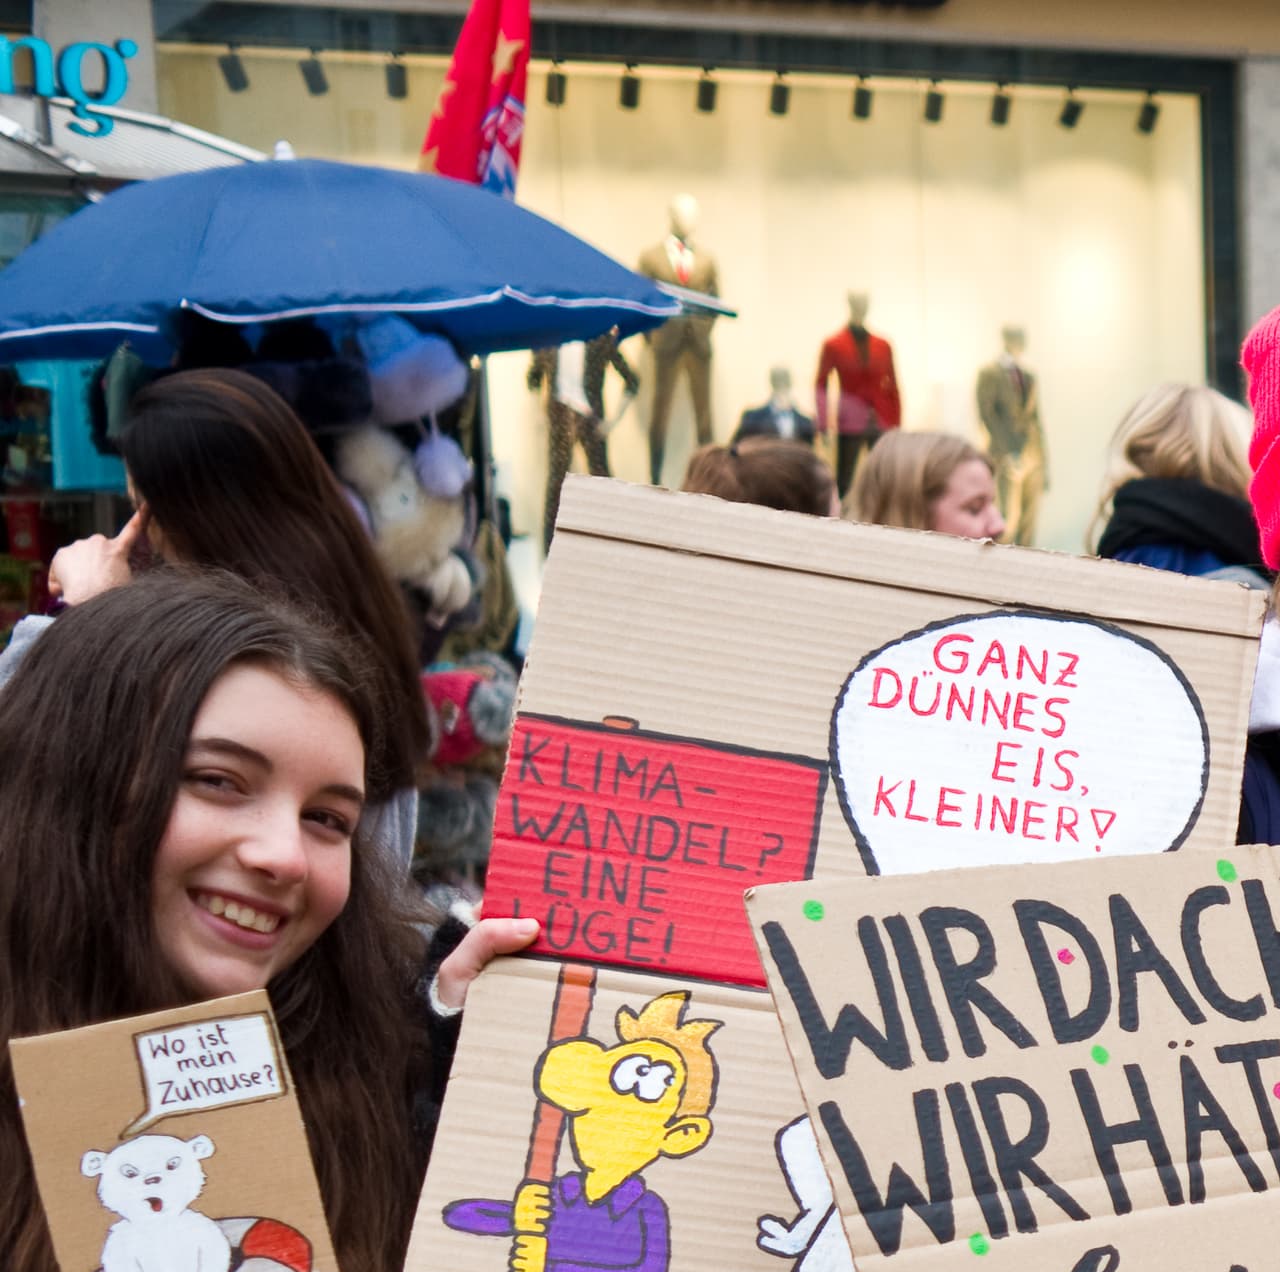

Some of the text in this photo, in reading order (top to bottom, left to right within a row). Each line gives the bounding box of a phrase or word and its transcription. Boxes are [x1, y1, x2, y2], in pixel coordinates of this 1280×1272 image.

[933, 633, 1079, 688] GANZ
[868, 668, 1070, 739] DÜNNES
[519, 731, 716, 808] KLIMA-
[991, 741, 1089, 796] EIS,
[511, 793, 784, 877] WANDEL?
[873, 776, 1117, 852] KLEINER!
[542, 850, 670, 914] EINE
[762, 906, 1036, 1080] WIR
[148, 1024, 228, 1058] Wo ist
[177, 1050, 237, 1072] mein
[158, 1064, 275, 1105] Zuhause?
[818, 1077, 1092, 1255] WIR
